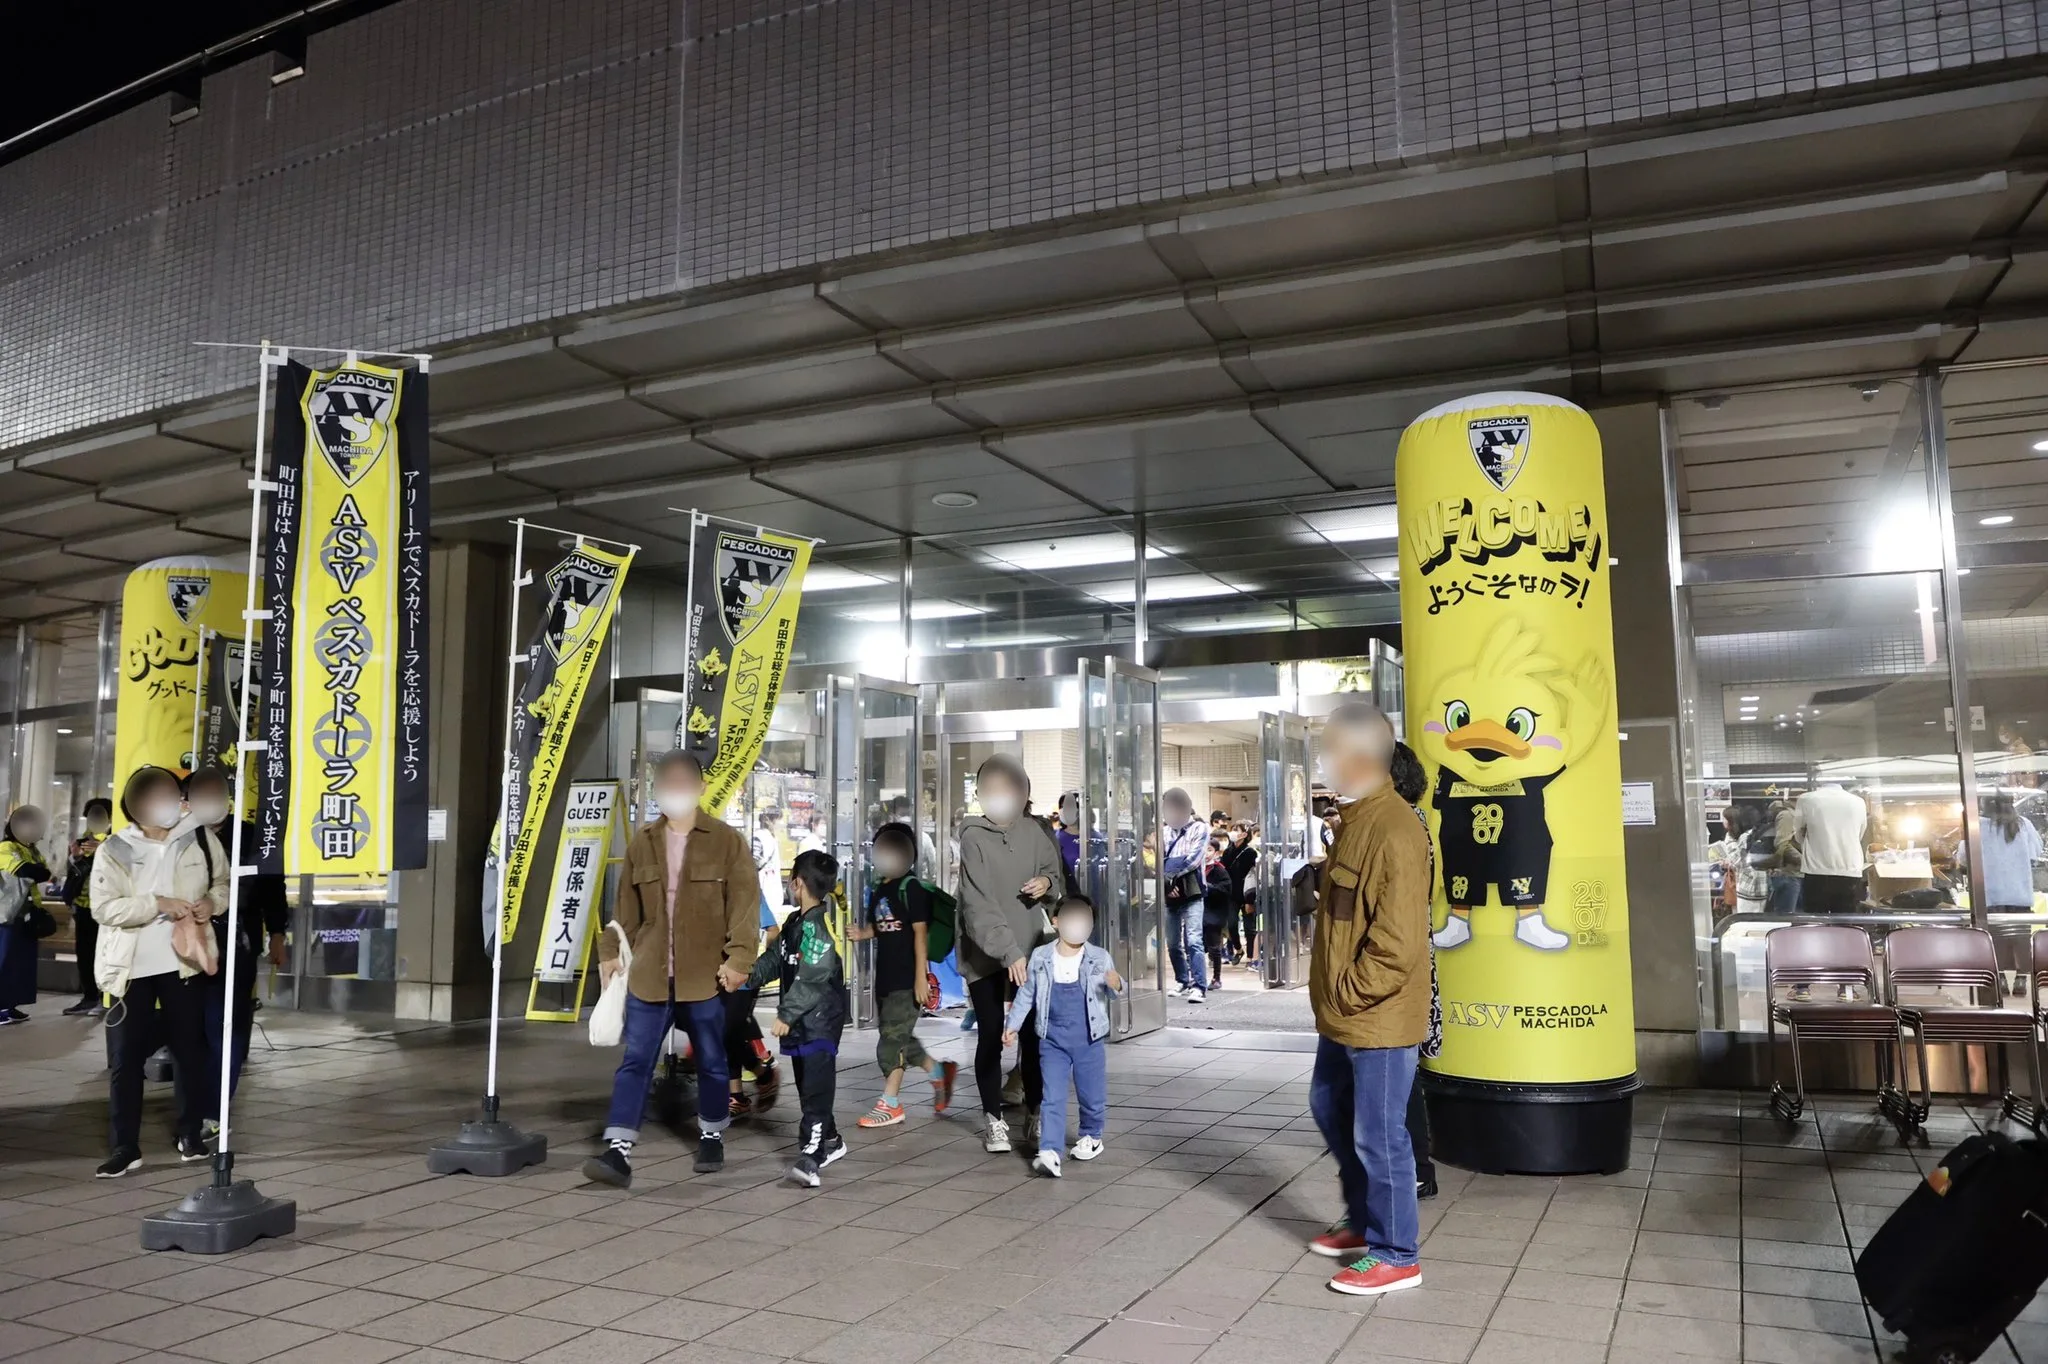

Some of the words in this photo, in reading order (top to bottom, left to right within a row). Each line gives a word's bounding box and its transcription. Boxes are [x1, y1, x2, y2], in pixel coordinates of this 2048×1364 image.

[317, 373, 393, 391] PCADOLA
[1470, 418, 1528, 429] PESCADOLA
[328, 445, 373, 455] MACHIDA
[722, 539, 792, 560] PESCADOLA
[402, 470, 421, 782] アリーナでペスカドーラを応援しよう
[259, 464, 297, 859] 町田市はASVペスカドーラ町田を応援しています
[321, 494, 367, 860] ASVペスカドーラ町田
[578, 791, 607, 804] VIP
[567, 807, 610, 820] GUEST
[551, 847, 590, 969] 関係者入口
[1449, 1002, 1510, 1029] ASV
[1514, 1004, 1608, 1017] PESCADOLA
[1522, 1017, 1595, 1029] MACHIDA
